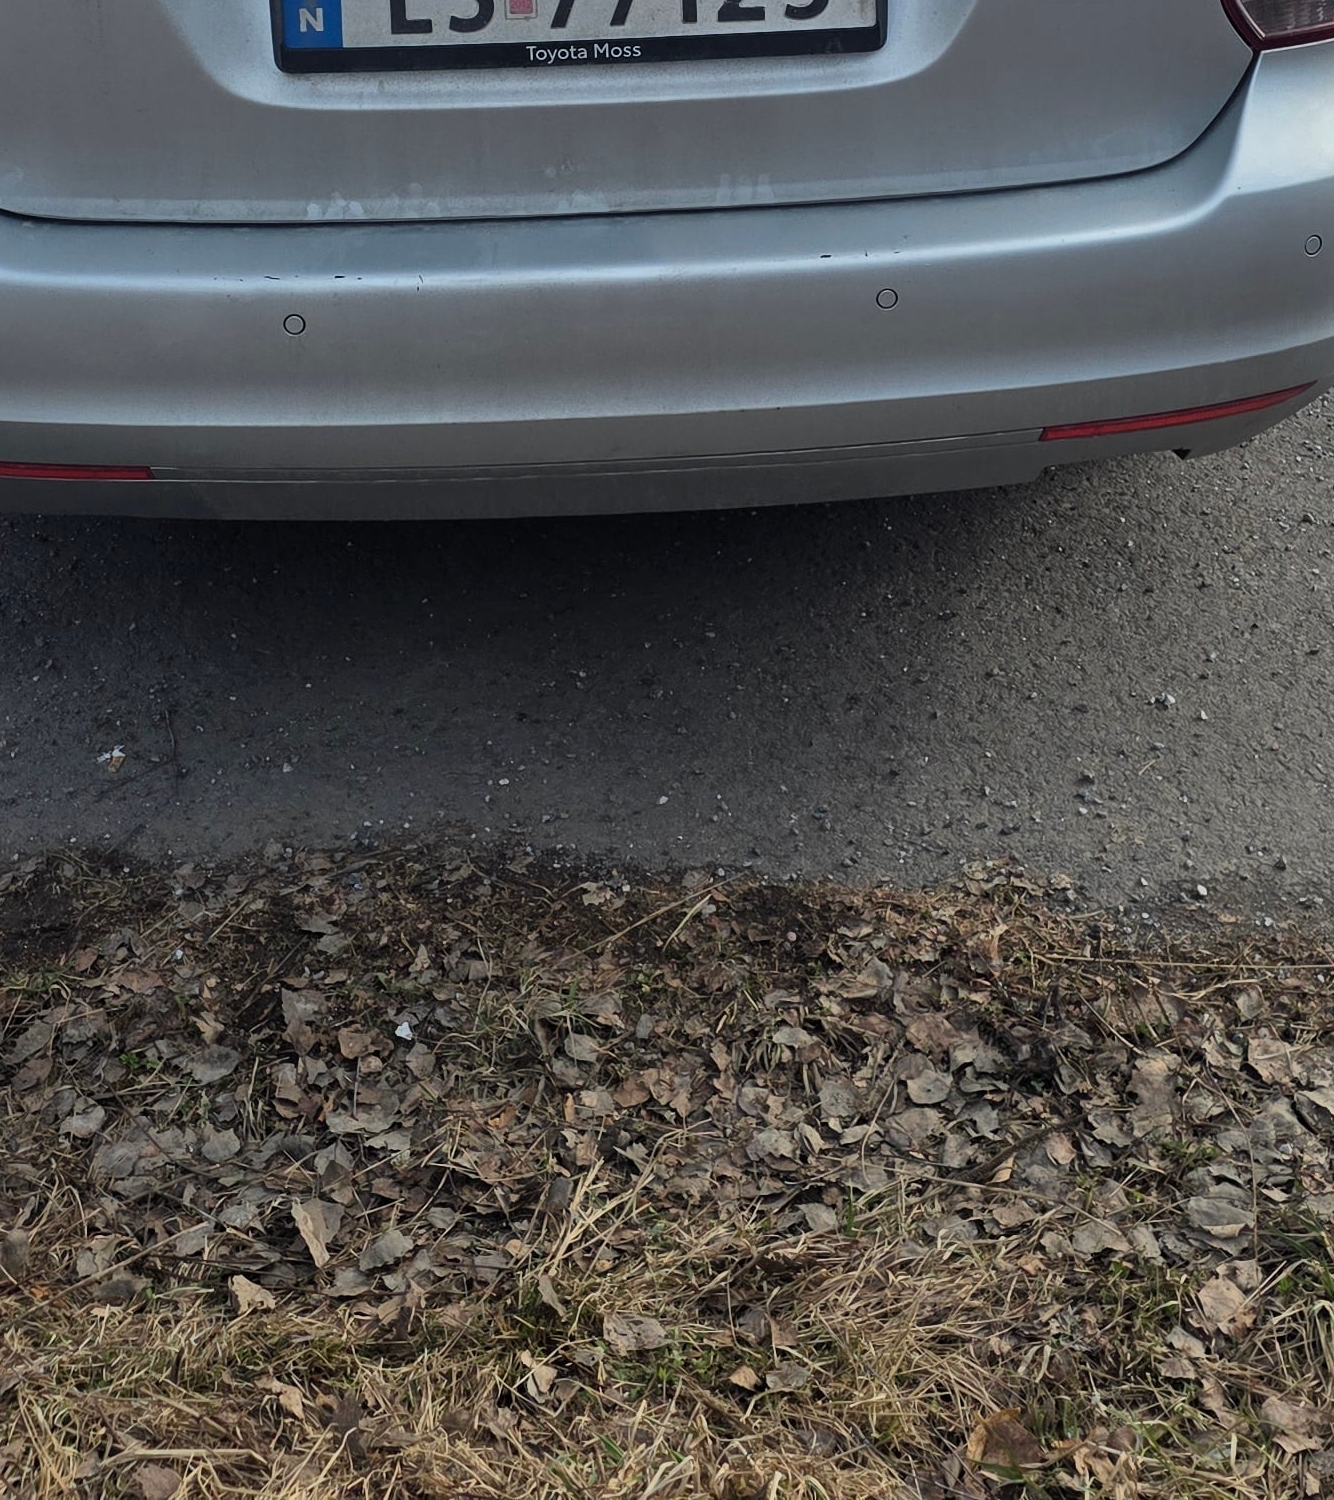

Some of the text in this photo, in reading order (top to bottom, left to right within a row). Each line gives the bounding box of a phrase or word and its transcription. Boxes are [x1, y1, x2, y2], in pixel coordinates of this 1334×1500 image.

[298, 7, 324, 32] N
[526, 43, 642, 64] Toyota Moss
